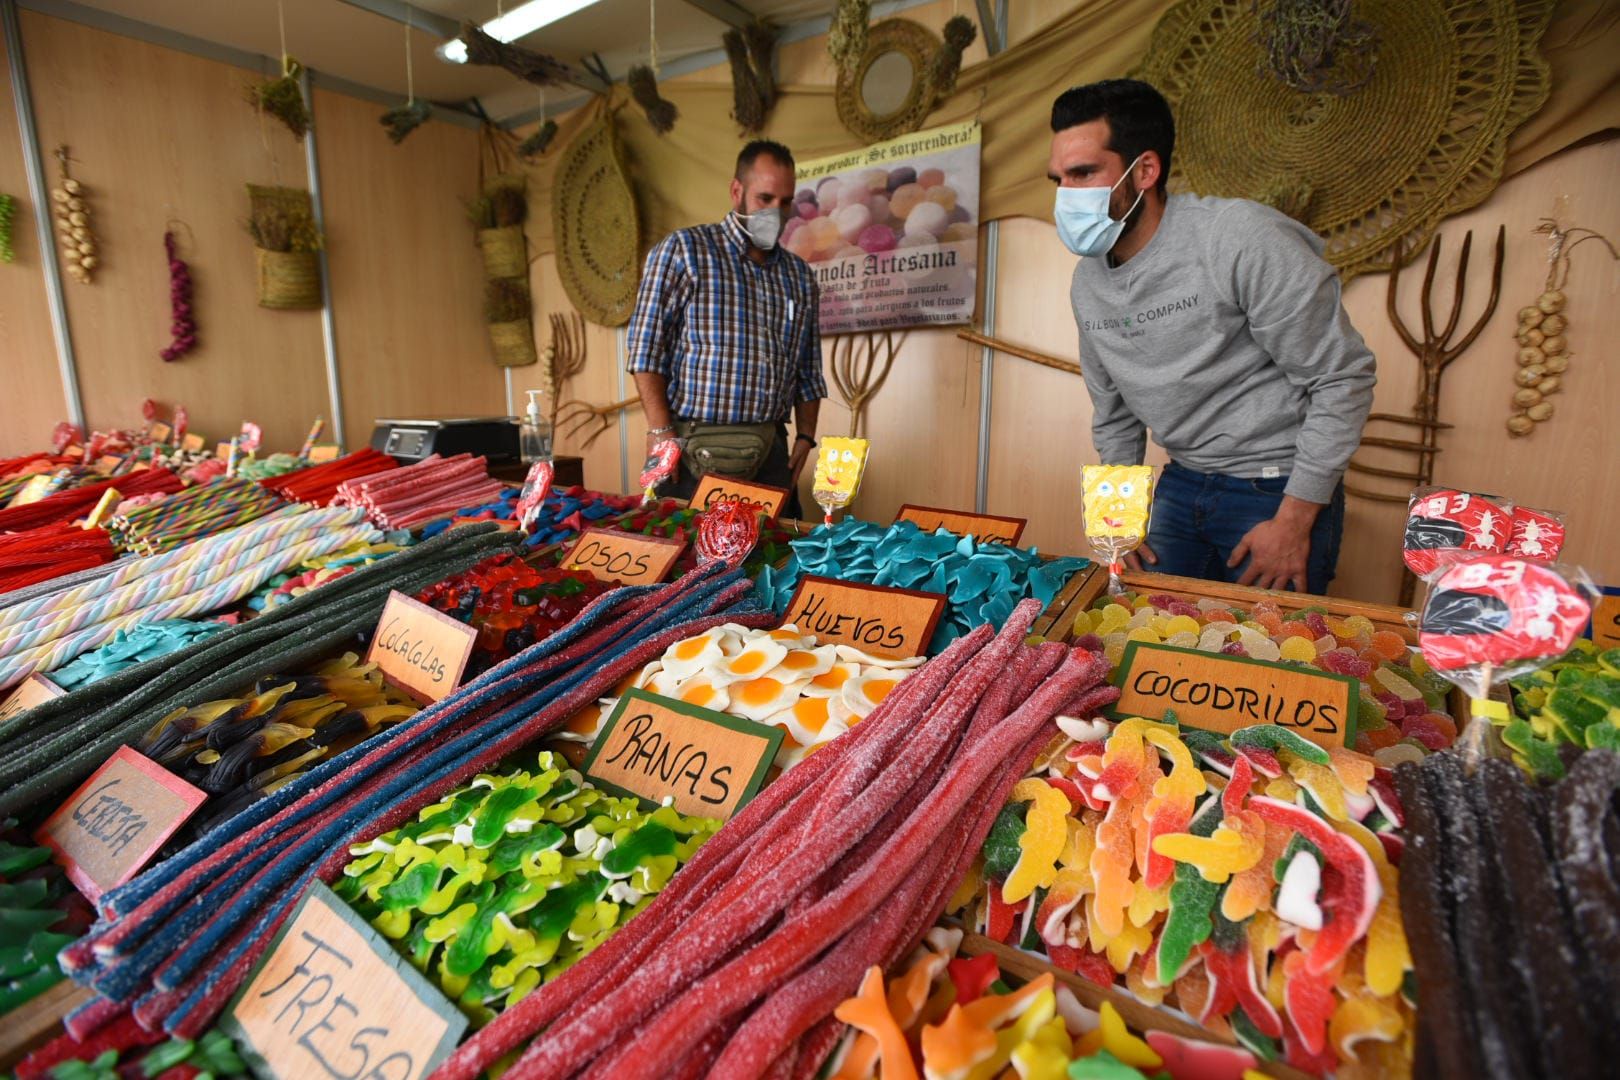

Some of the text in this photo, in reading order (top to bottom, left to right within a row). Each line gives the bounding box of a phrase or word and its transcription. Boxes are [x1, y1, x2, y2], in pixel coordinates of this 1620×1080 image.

[826, 155, 860, 174] probar
[889, 129, 973, 157] sorprenderá!
[862, 250, 957, 277] Artesana
[846, 281, 857, 290] de
[860, 277, 891, 291] Fruta
[921, 298, 935, 307] los
[937, 297, 966, 306] frutos
[1084, 294, 1199, 331] SILBON COMPANY
[1428, 493, 1471, 516] 93
[575, 541, 651, 576] OSOS
[796, 593, 904, 649] HUEVOS
[1133, 670, 1338, 734] COCODRILOS
[605, 714, 732, 805] RANAS
